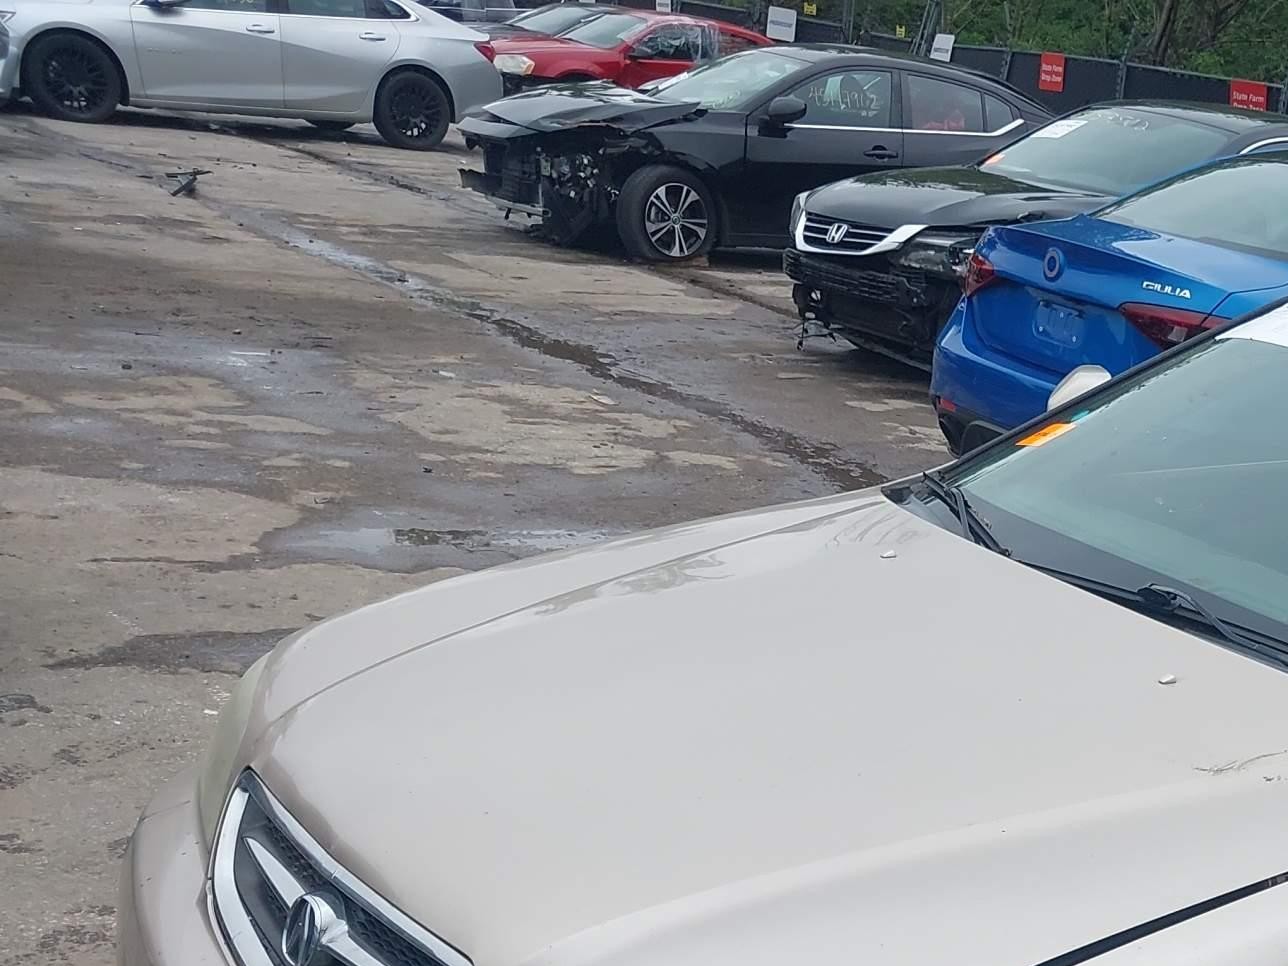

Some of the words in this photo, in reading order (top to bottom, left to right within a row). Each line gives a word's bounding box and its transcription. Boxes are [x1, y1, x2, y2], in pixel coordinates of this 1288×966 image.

[1233, 91, 1248, 101] State
[1249, 93, 1265, 103] Farm
[1142, 281, 1192, 299] GIULIA
